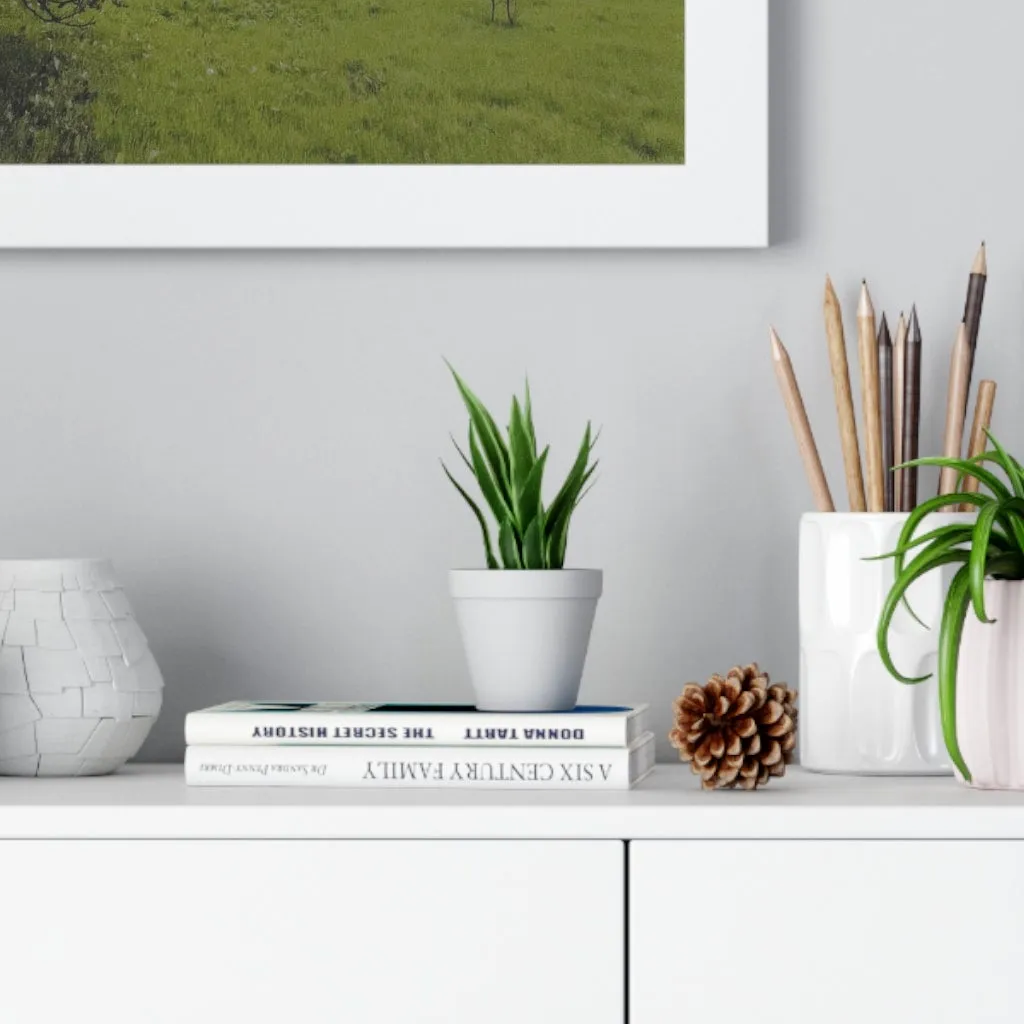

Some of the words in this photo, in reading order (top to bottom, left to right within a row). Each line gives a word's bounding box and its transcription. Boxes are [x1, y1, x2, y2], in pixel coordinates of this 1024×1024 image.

[251, 727, 328, 739] HISTORY
[333, 727, 397, 739] SECRET
[402, 727, 434, 739] THE
[464, 728, 519, 740] TARTT
[523, 728, 585, 740] DONNA
[362, 762, 444, 780] FAMILY
[449, 763, 554, 781] CENTURY
[560, 764, 594, 781] SIX
[598, 764, 613, 781] A
